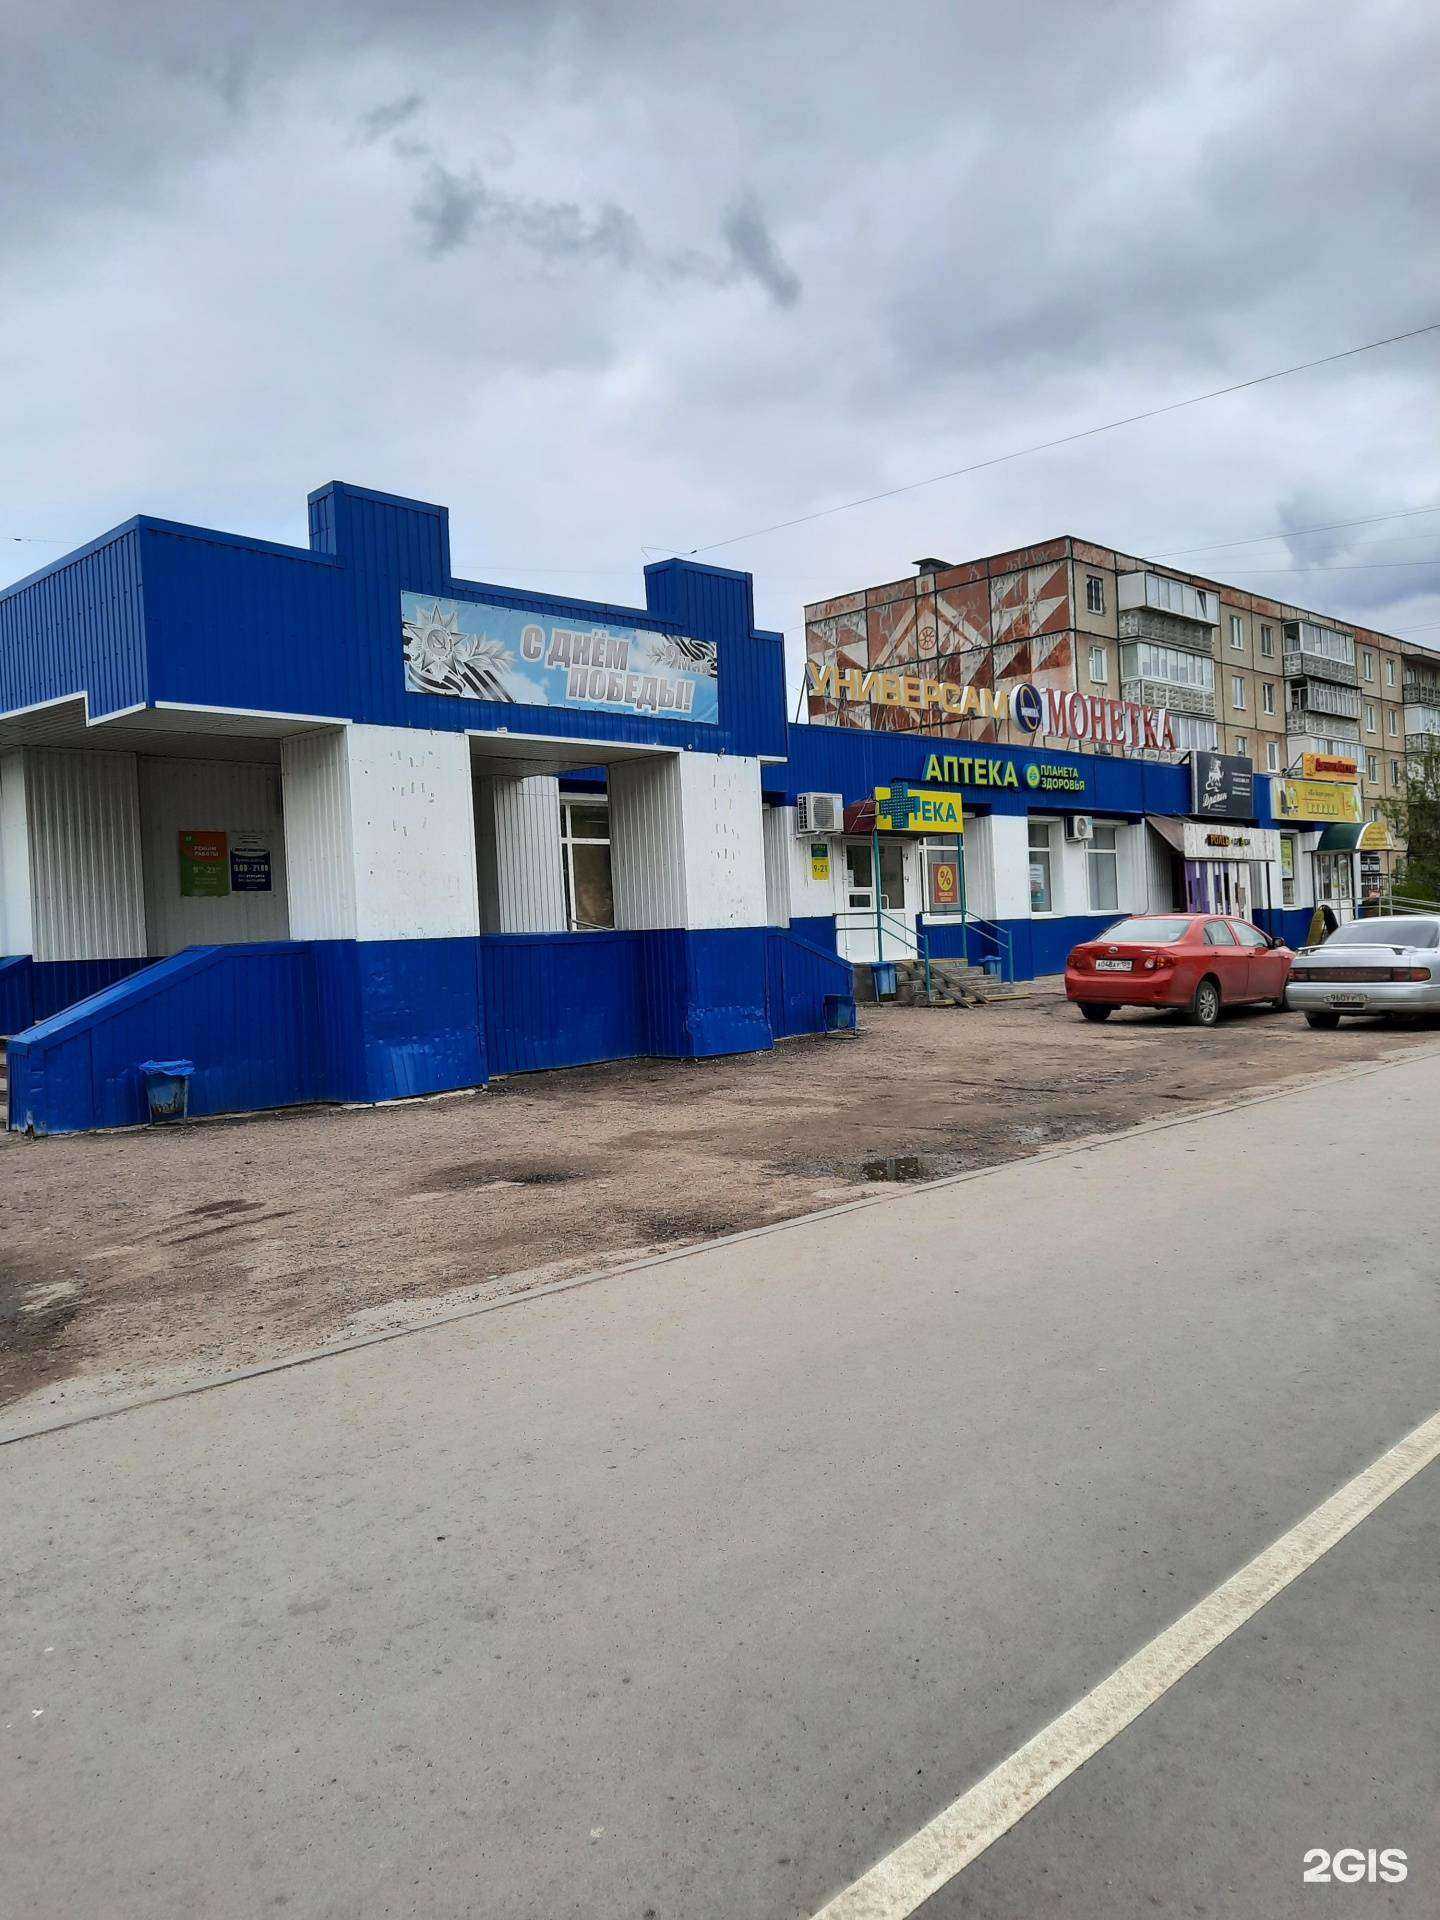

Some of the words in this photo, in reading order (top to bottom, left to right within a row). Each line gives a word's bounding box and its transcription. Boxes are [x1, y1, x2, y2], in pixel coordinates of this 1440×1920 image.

[521, 625, 544, 660] С
[547, 630, 630, 671] ДНЁМ
[567, 668, 695, 712] ПОБЕДЫ!
[806, 663, 1009, 720] УНИВЕРСАМ
[1041, 688, 1177, 751] МОНЕТКА
[926, 754, 1018, 788] АПТЕКА
[1040, 765, 1079, 779] ПЛАНЕТА
[1041, 778, 1085, 791] ЗДОРОВЬЯ
